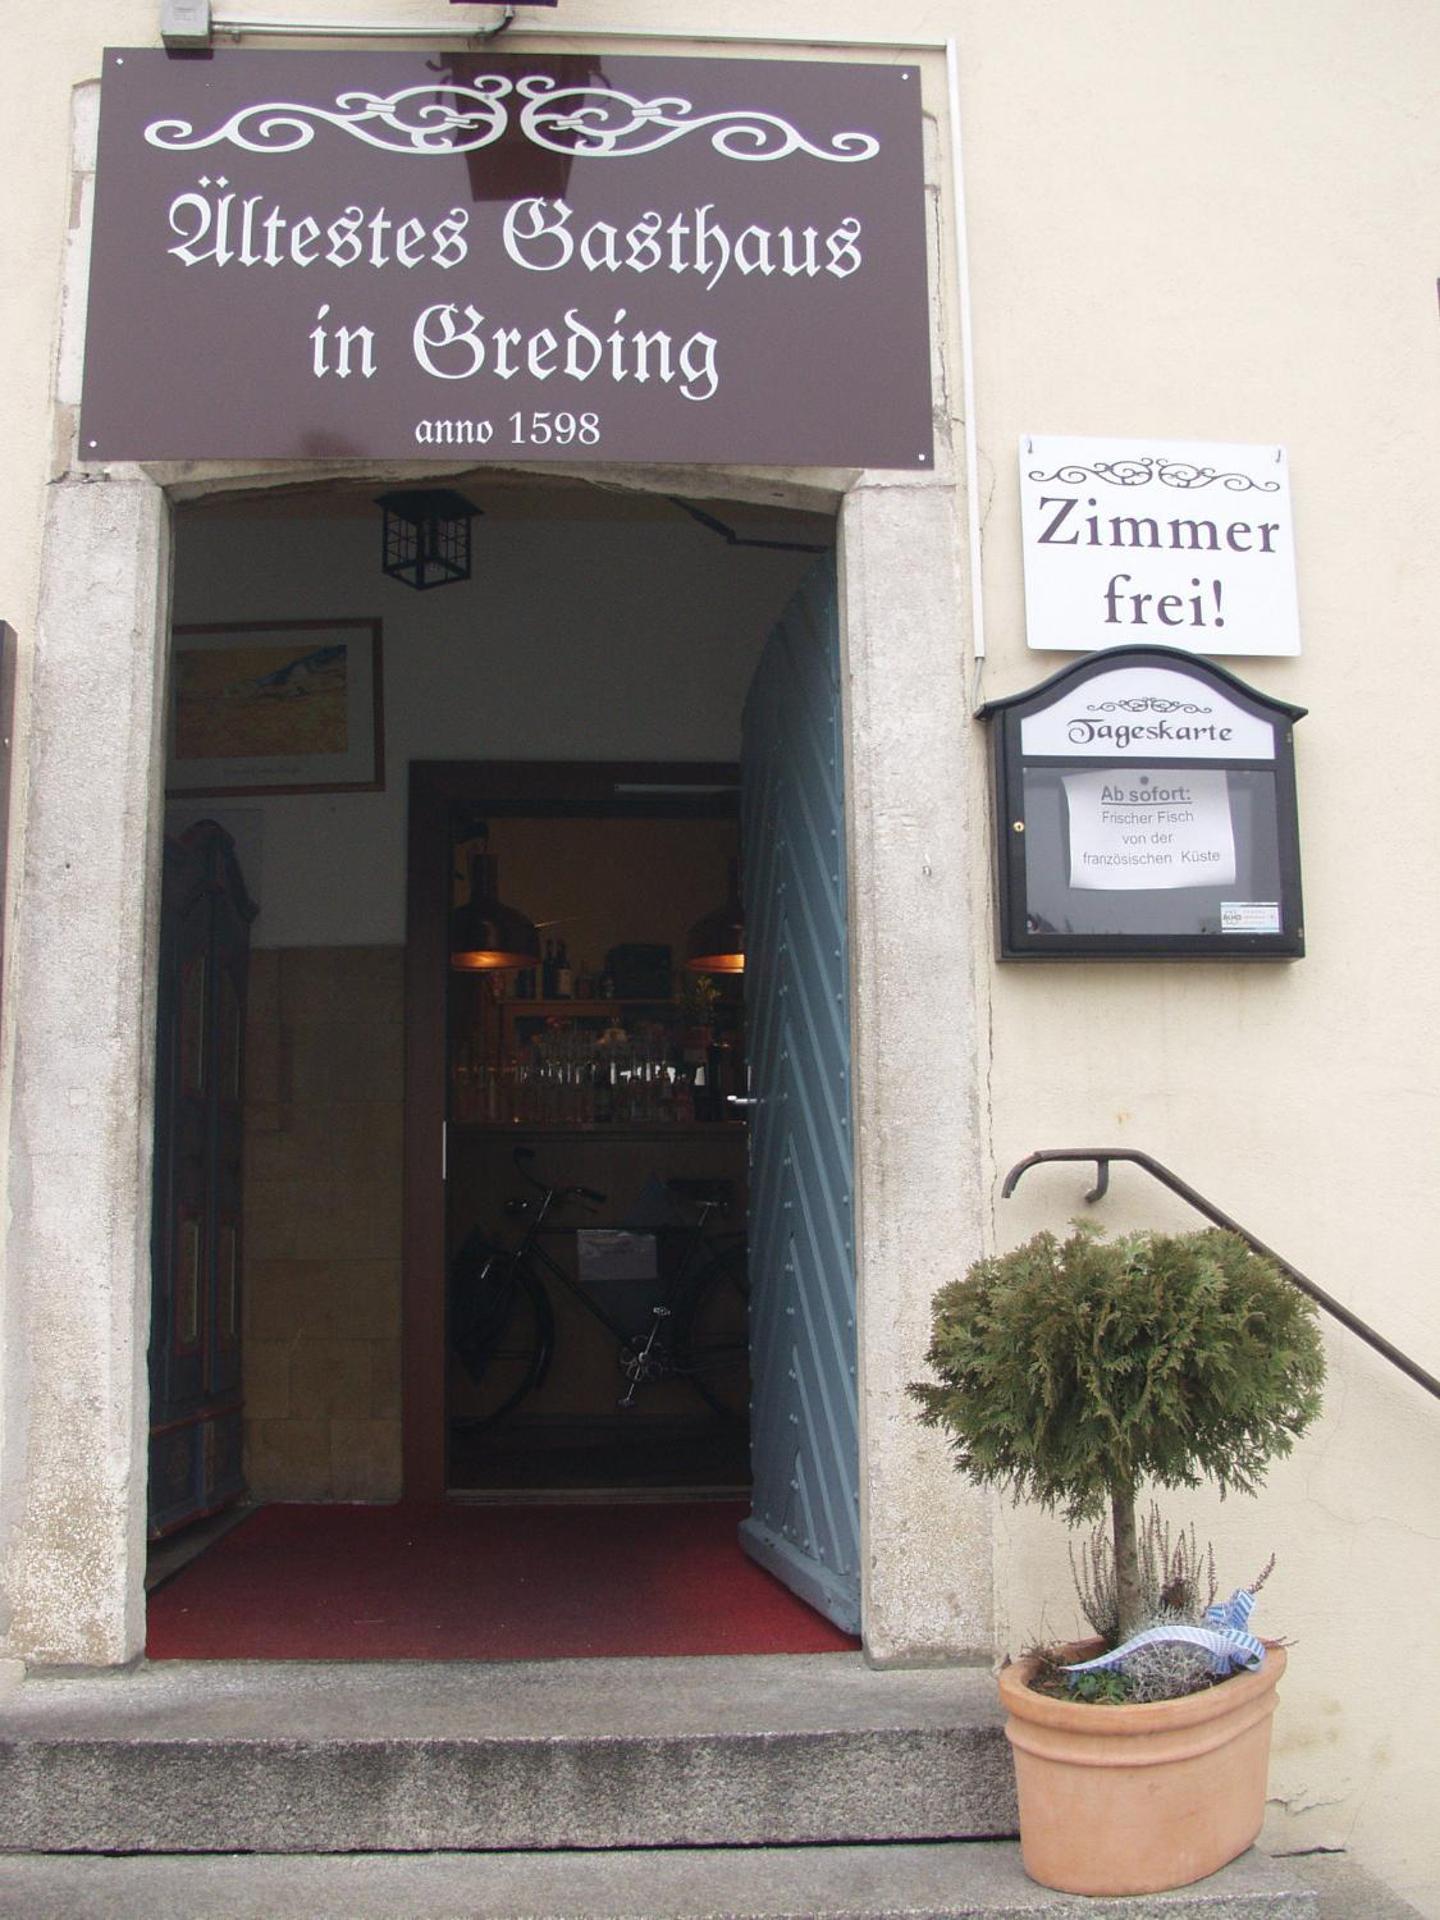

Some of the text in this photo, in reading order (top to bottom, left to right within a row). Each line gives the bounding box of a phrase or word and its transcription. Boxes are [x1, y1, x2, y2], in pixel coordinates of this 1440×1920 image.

[168, 176, 862, 291] Ältestes Gasthaus
[310, 304, 719, 401] in Greding
[415, 412, 601, 445] anno 1598
[1038, 497, 1280, 554] Zimmer
[1103, 574, 1225, 627] frei!
[1067, 718, 1233, 749] Tageskarte
[1101, 785, 1192, 802] Ab sofort:
[1102, 810, 1194, 825] Frischer Fisch
[1122, 832, 1174, 845] von der
[1083, 850, 1221, 866] französischen Küste
